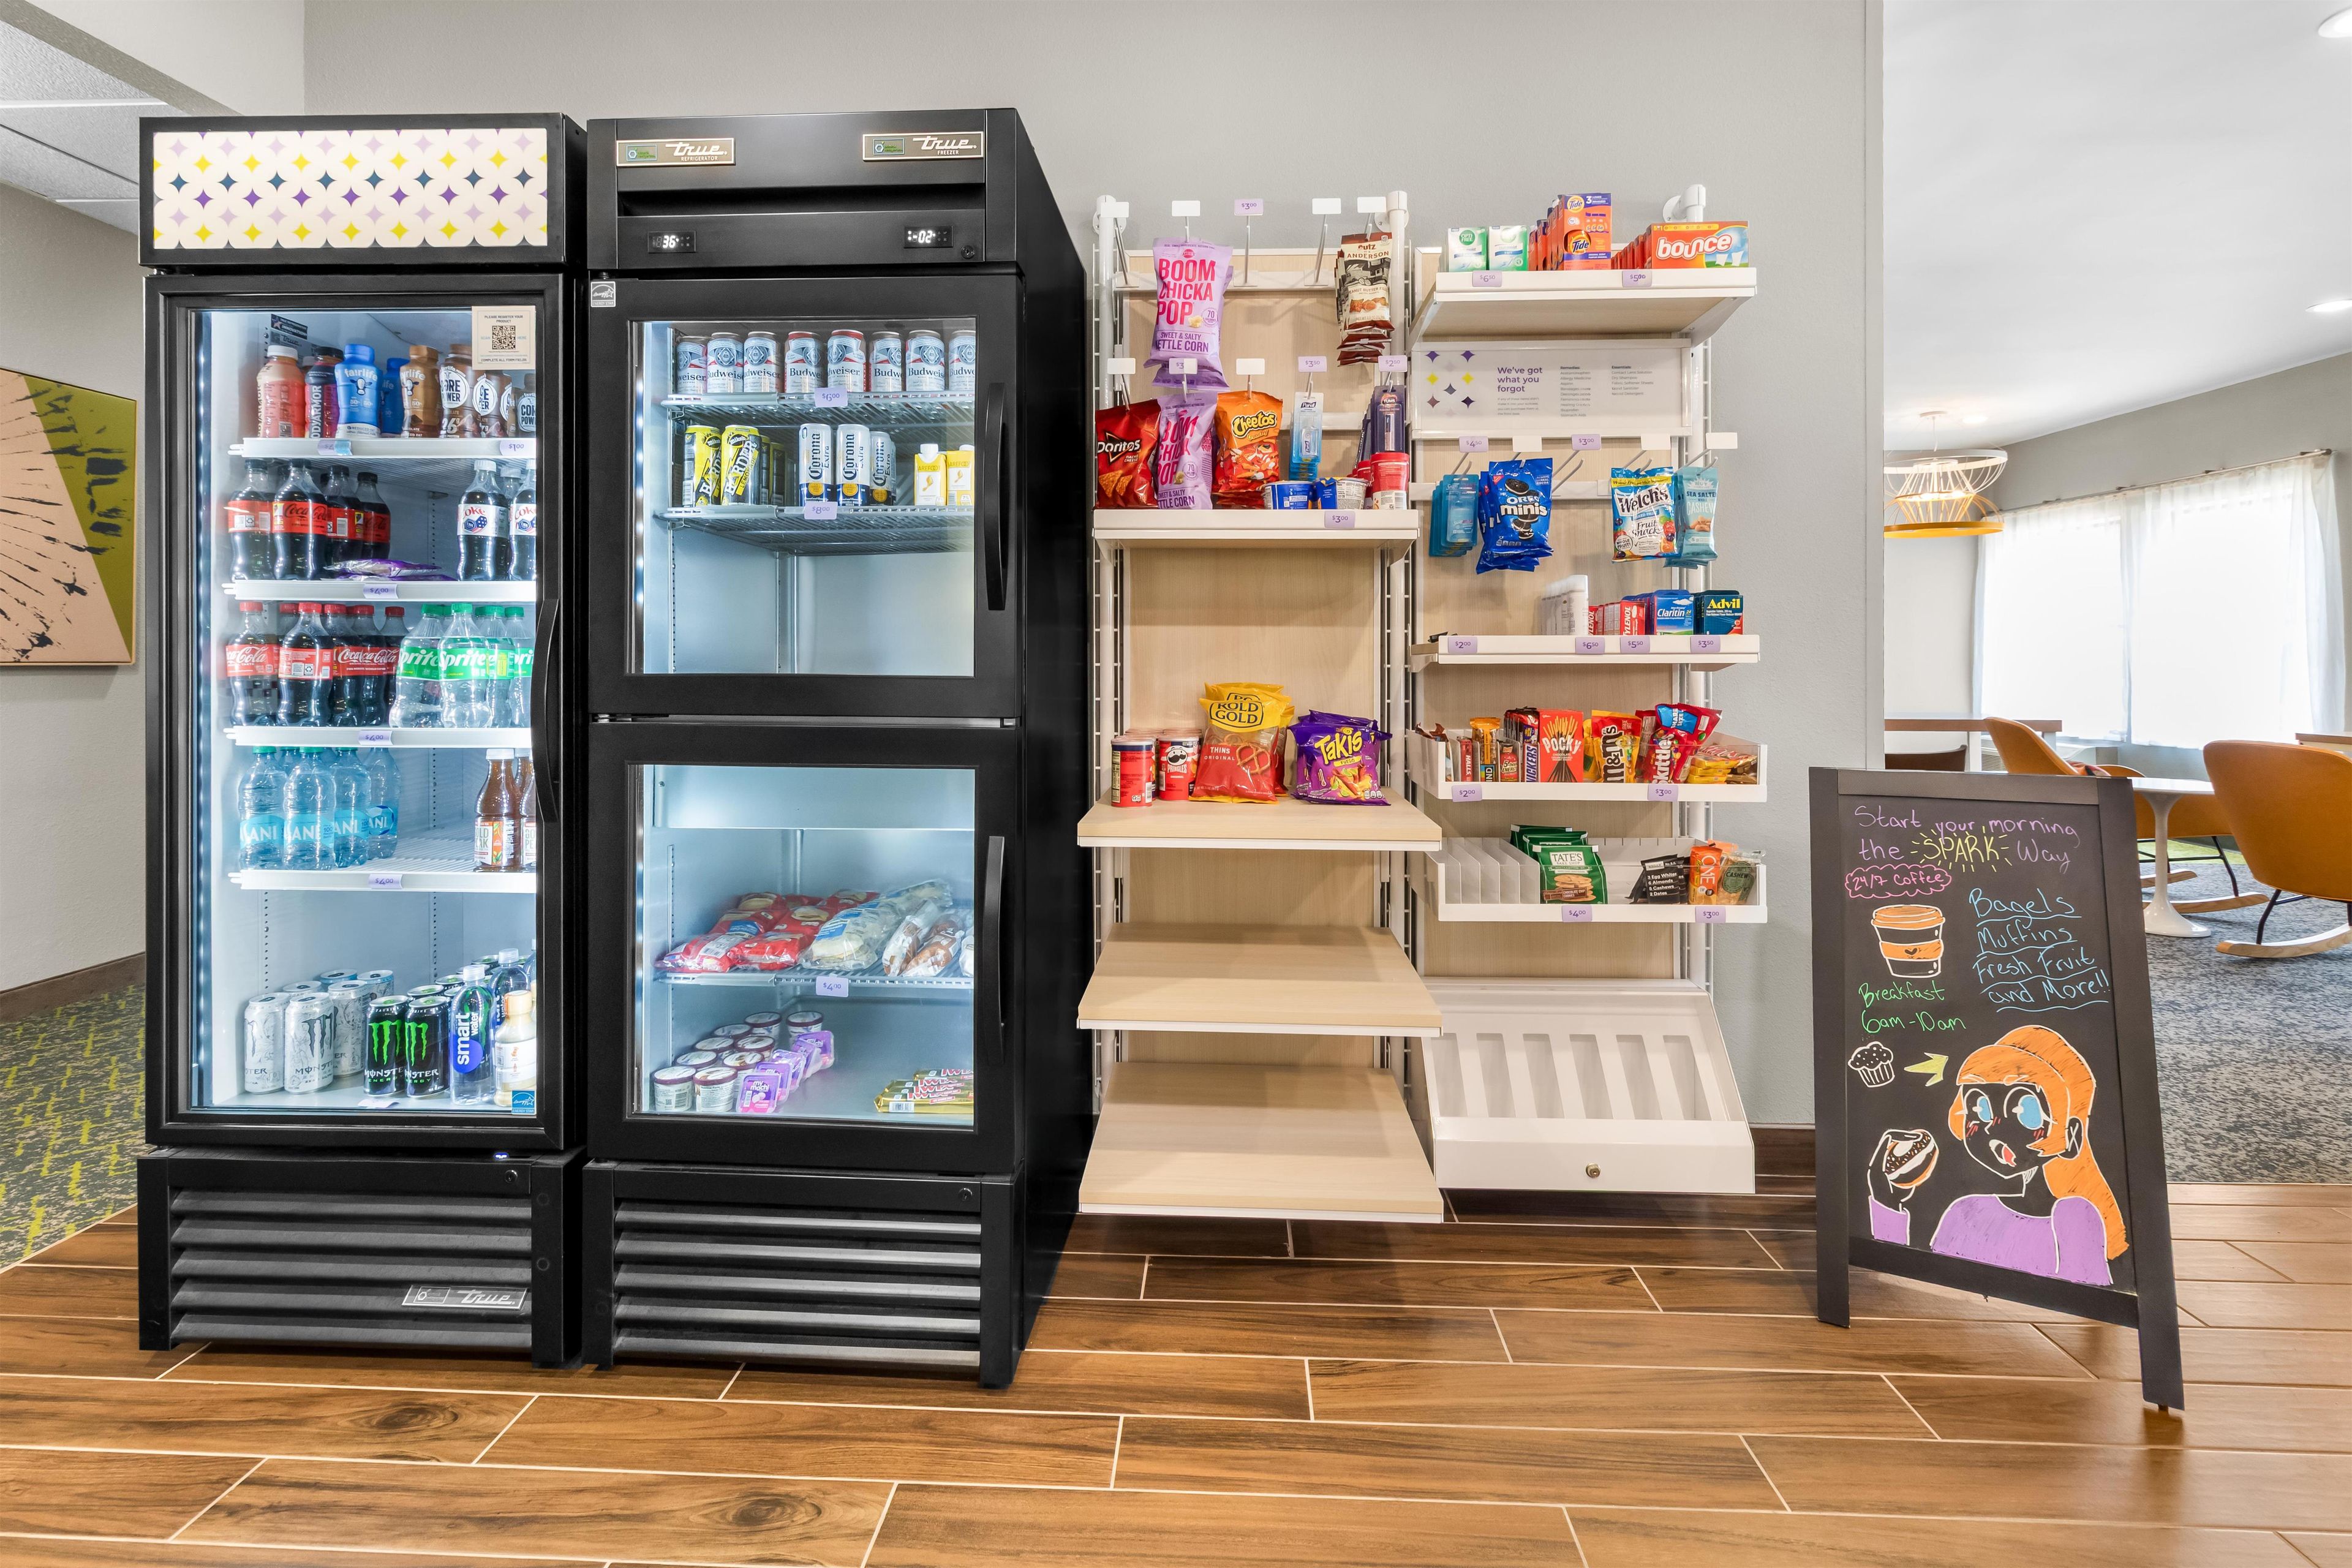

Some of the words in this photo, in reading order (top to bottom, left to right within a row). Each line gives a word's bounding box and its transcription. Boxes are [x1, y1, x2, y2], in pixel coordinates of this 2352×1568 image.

[1569, 200, 1583, 209] Tide
[1572, 240, 1589, 254] Tide
[1657, 235, 1732, 258] bounce
[1347, 251, 1389, 259] ANDERSON
[1159, 258, 1216, 282] BOOM
[1159, 282, 1213, 301] CHICKA
[1156, 301, 1194, 326] POP
[1207, 310, 1215, 318] 70
[1184, 341, 1209, 352] CORN
[344, 369, 378, 381] fairlife
[1527, 367, 1542, 375] got
[311, 385, 322, 438] ODYARMOR
[1234, 412, 1276, 436] Cheetos
[1097, 439, 1140, 453] Doritos
[1174, 495, 1195, 508] CORN
[1618, 488, 1668, 513] Welch's
[1500, 502, 1548, 516] minis
[1637, 519, 1657, 531] Fruit
[1707, 598, 1740, 609] Advil
[1657, 609, 1685, 617] Claritin
[1215, 710, 1258, 724] GOLD
[1314, 727, 1363, 765] Takis
[1167, 764, 1187, 774] PRINGLES
[1855, 805, 1921, 828] Start
[1935, 820, 1975, 842] your
[1989, 818, 2080, 848] morning
[1551, 853, 1583, 862] TATE'S
[1859, 839, 1904, 861] the
[1924, 835, 2000, 862] SPARK
[2017, 839, 2071, 874] Way
[1853, 875, 1888, 891] 24/7
[1969, 888, 2075, 929] Bagels
[1977, 921, 2073, 954] Muffins
[1972, 956, 2032, 984] Fresh
[2037, 946, 2095, 976] Fruit
[1858, 980, 1945, 1008] Breakfast
[1988, 981, 2035, 1003] and
[456, 1012, 470, 1065] smart
